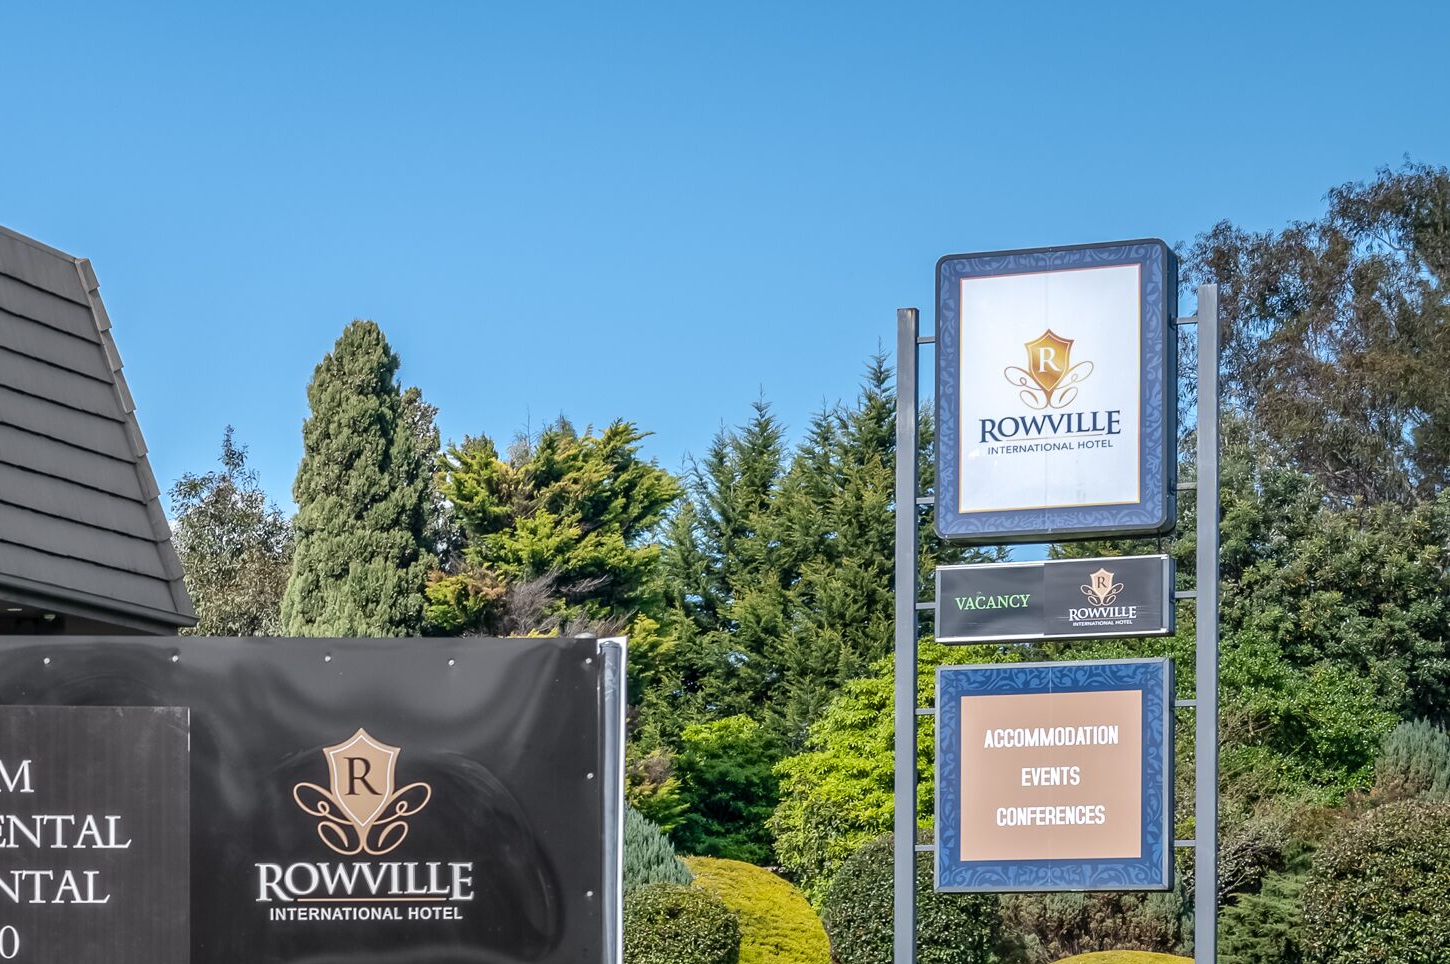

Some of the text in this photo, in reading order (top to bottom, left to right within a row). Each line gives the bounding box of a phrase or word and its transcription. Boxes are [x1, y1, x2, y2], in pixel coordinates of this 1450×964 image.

[1038, 346, 1061, 373] R
[979, 410, 1121, 444] ROWVILLE
[988, 439, 1114, 455] INTERNATIONAL HOTEL
[1097, 576, 1107, 588] R
[955, 594, 1031, 610] VACANCY
[1068, 606, 1137, 621] ROWVILLE
[983, 725, 1119, 749] ACCOMMODATION
[343, 756, 381, 796] R
[1021, 765, 1081, 787] EVENTS
[996, 805, 1106, 827] CONFERENCES
[254, 861, 475, 903] ROWVILLE
[269, 906, 464, 921] INTERNATIONAL HOTEL
